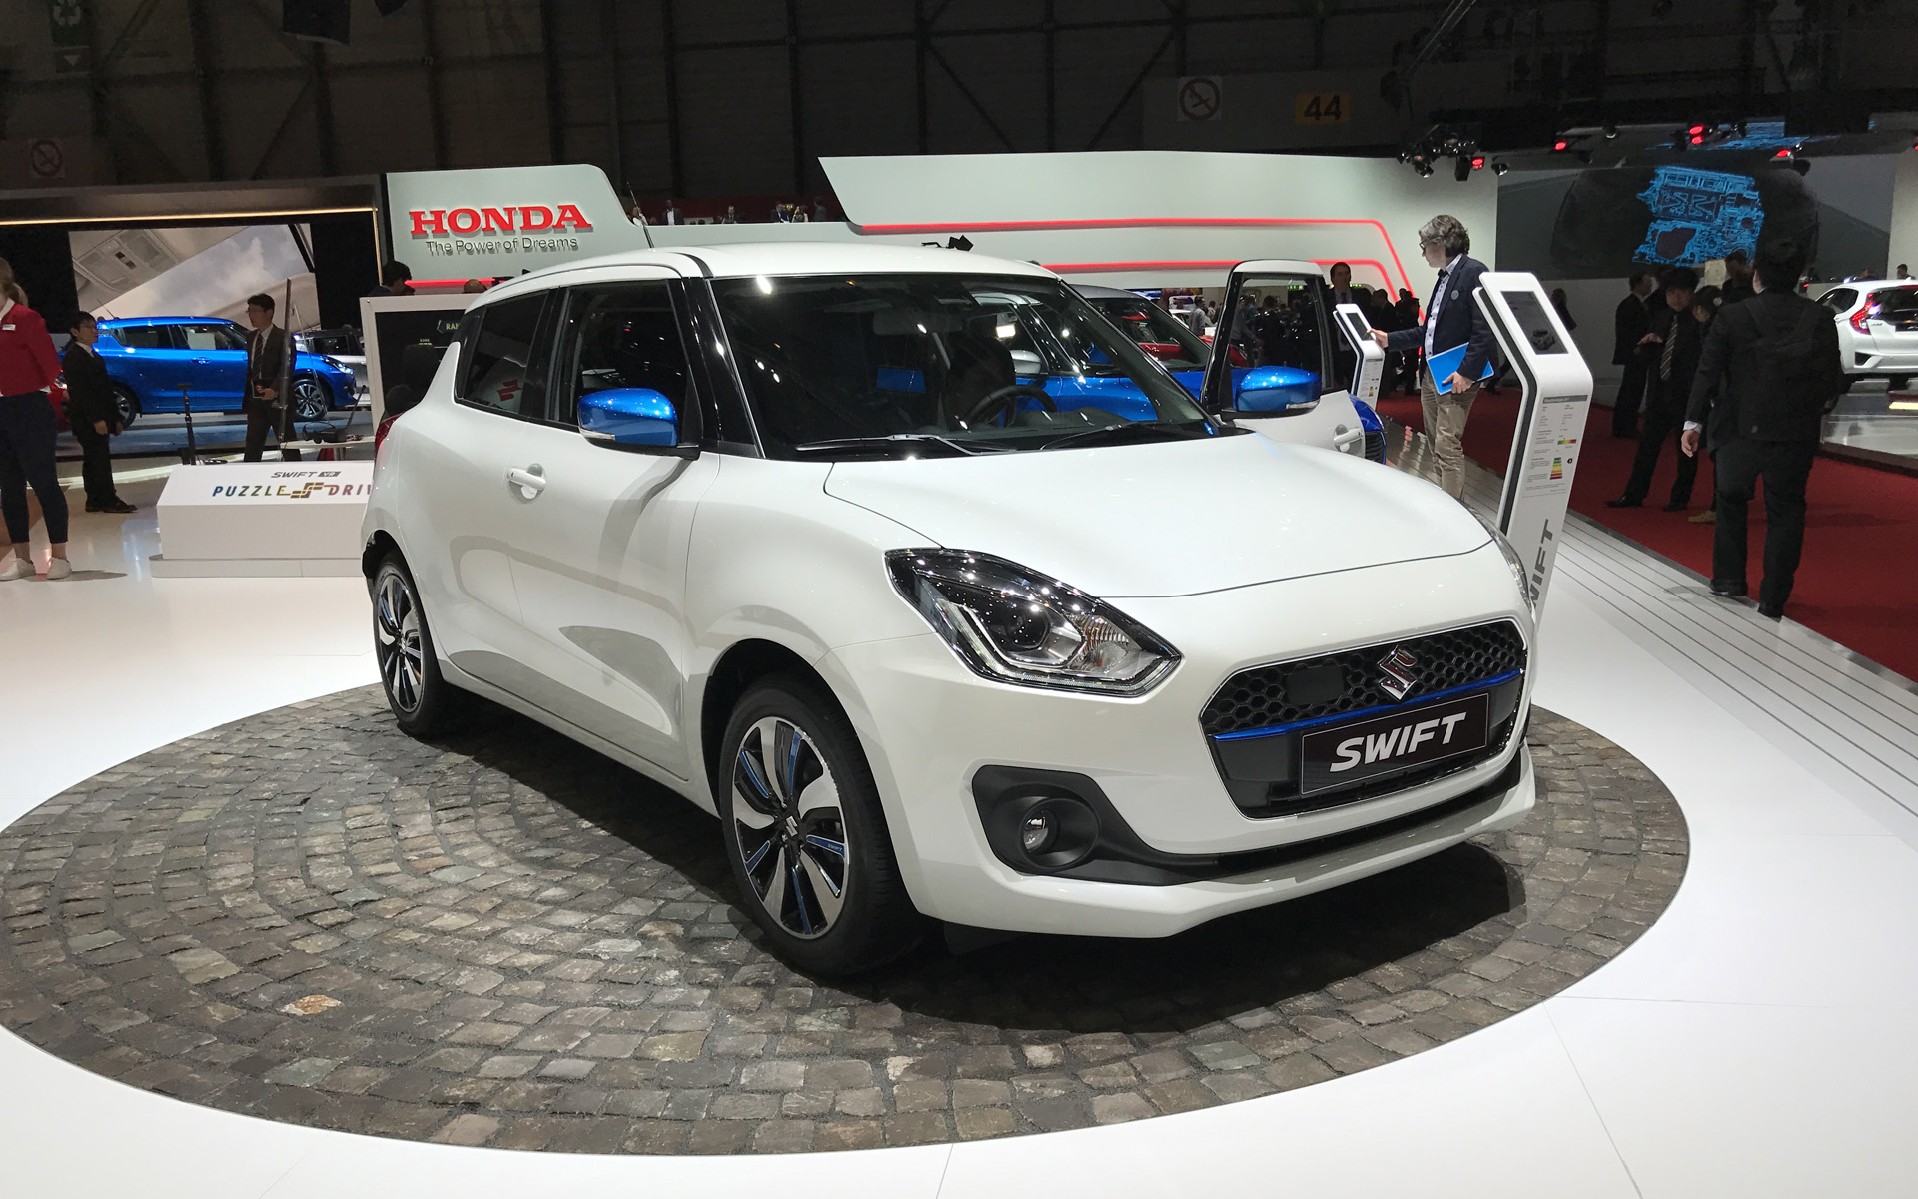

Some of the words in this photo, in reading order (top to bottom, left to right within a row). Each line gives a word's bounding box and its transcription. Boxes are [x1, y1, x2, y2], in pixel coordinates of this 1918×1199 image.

[1303, 95, 1342, 121] 44
[409, 205, 592, 235] HONDA
[427, 241, 452, 252] The
[456, 240, 500, 252] Power
[503, 238, 518, 250] of
[522, 237, 577, 250] Dreams
[212, 485, 287, 497] PUZZLE
[1329, 712, 1466, 772] SWIFT
